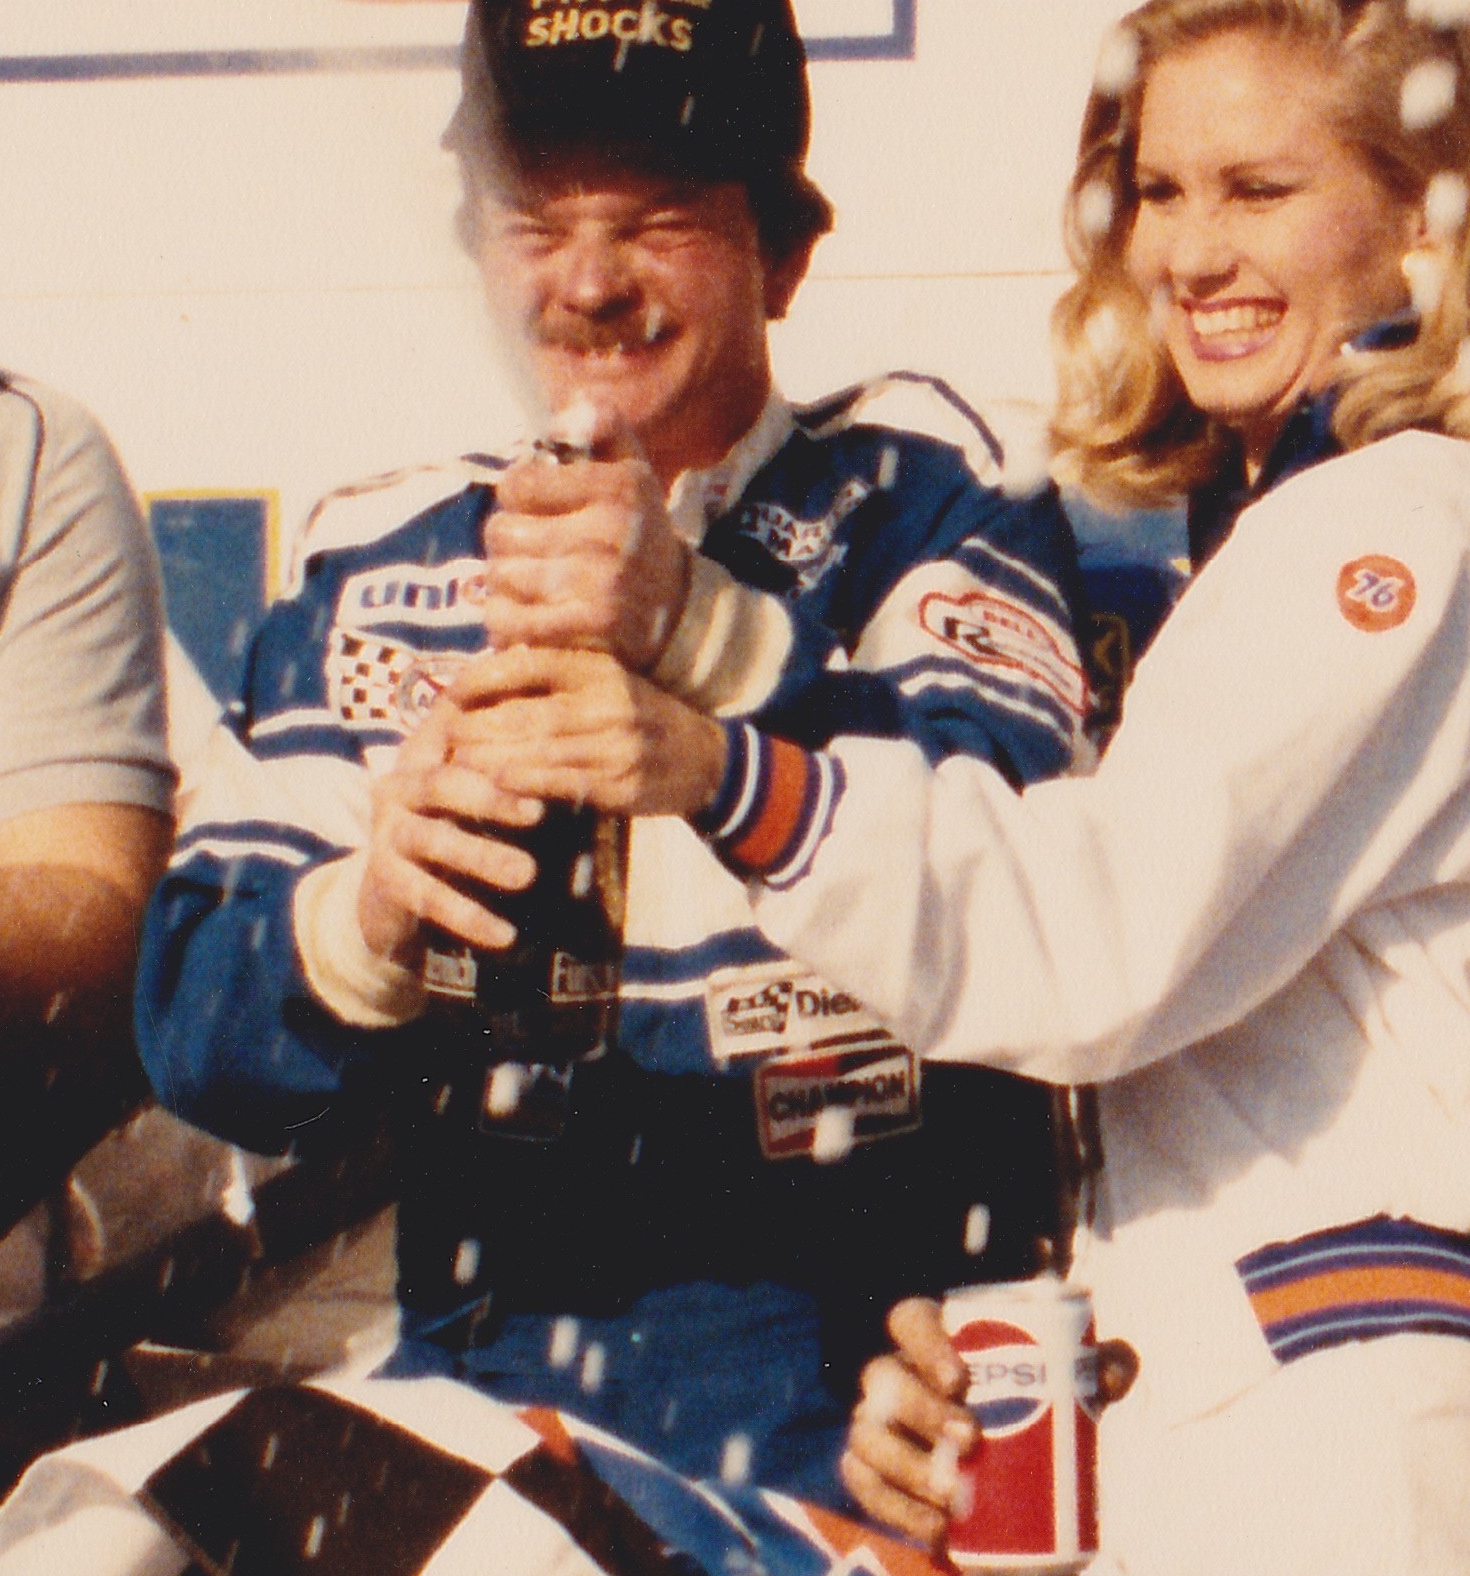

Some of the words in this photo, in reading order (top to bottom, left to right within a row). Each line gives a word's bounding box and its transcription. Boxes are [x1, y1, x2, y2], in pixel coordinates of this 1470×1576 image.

[526, 8, 693, 53] SHOCKS
[1353, 570, 1398, 610] 76
[967, 1362, 1047, 1387] EPSI
